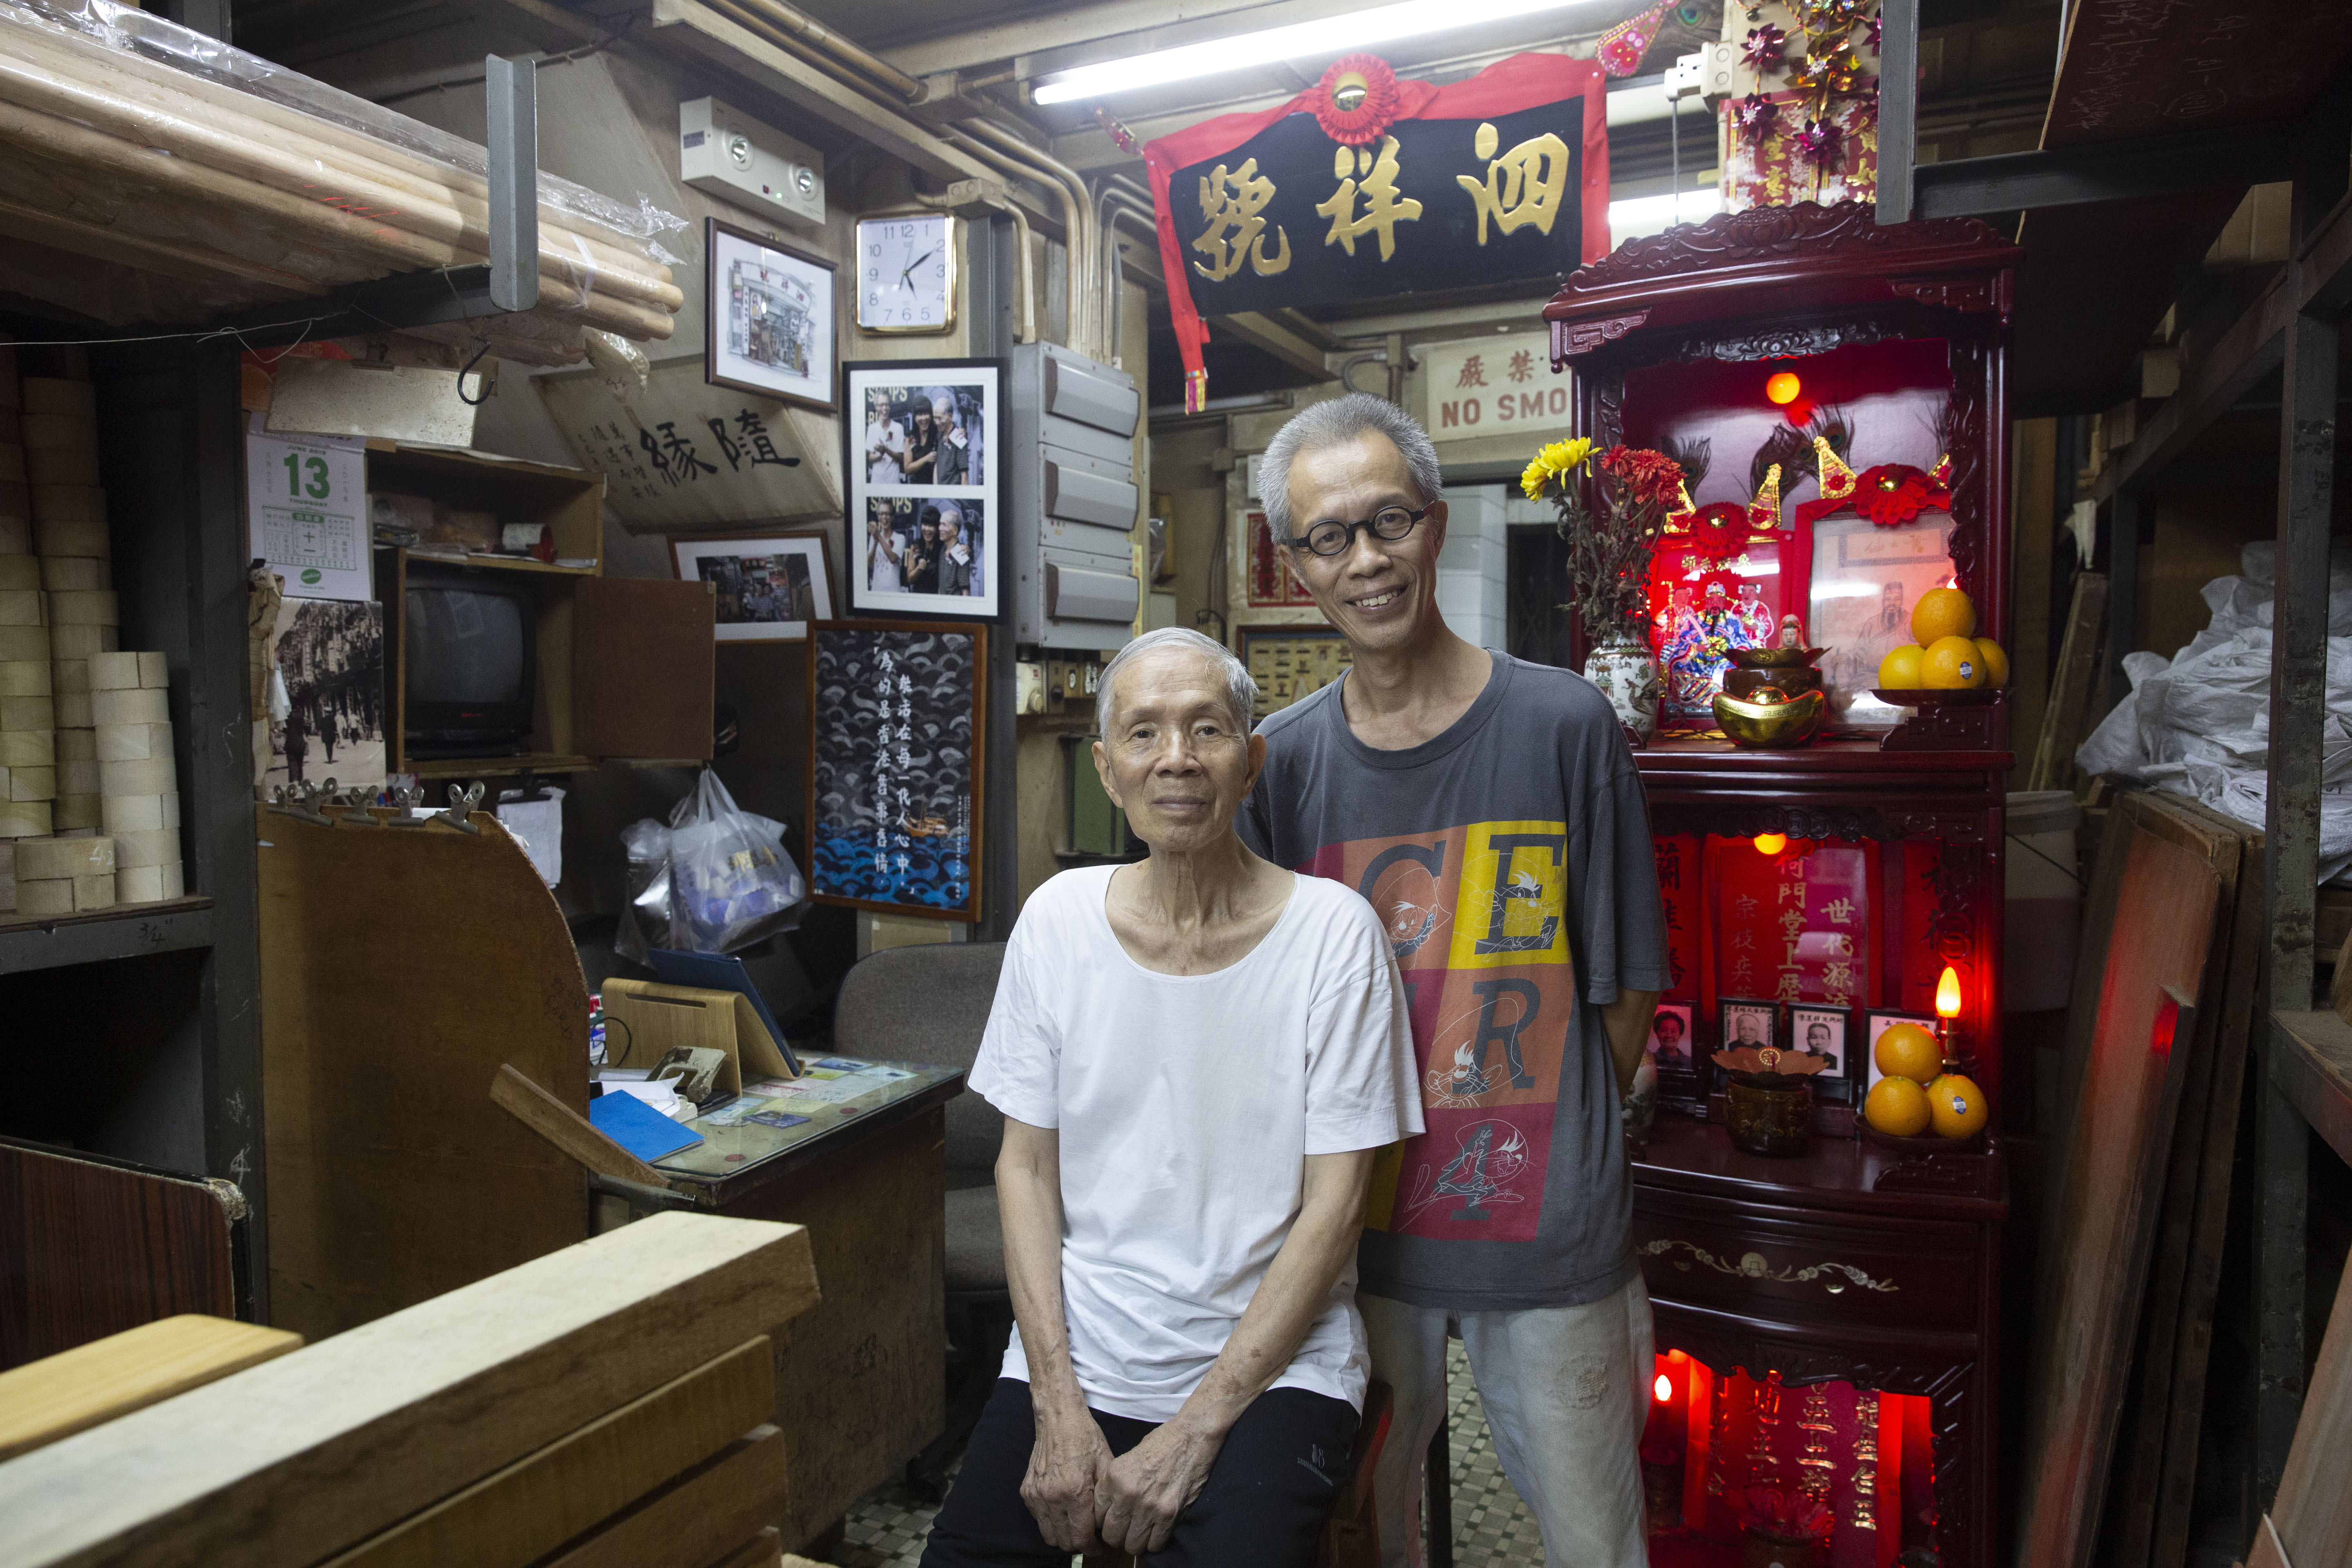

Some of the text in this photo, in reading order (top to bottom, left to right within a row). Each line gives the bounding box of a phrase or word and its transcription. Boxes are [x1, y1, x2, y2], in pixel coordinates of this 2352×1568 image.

[884, 226, 894, 239] 11
[901, 224, 914, 238] 12
[925, 224, 929, 236] 1
[869, 244, 882, 258] 10
[936, 238, 946, 253] 2
[869, 267, 878, 282] 9
[936, 264, 946, 278] 3
[869, 292, 878, 307] 8
[935, 289, 946, 303] 4
[884, 308, 894, 322] 7
[902, 307, 912, 321] 6
[920, 306, 930, 321] 5
[1441, 398, 1481, 428] NO
[283, 453, 330, 499] 13
